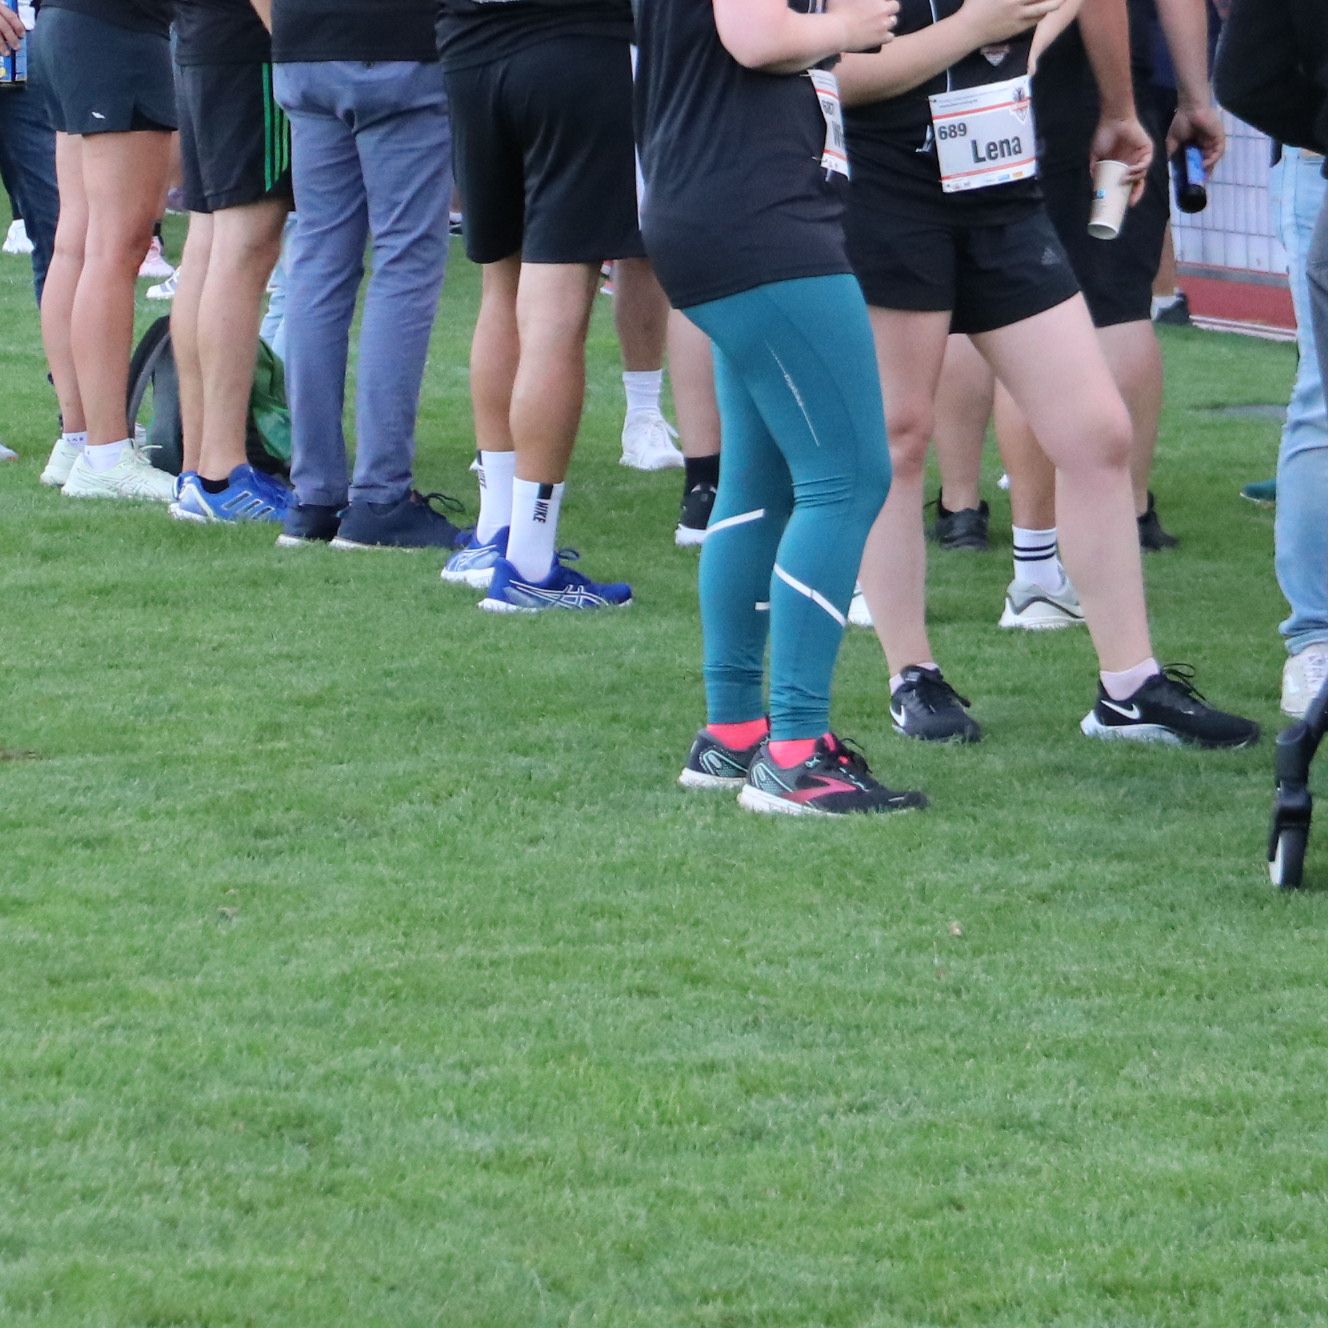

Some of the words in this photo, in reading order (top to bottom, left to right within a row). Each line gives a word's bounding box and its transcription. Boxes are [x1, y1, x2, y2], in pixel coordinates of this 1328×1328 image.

[938, 122, 967, 140] 689
[971, 136, 1022, 163] Lena
[533, 500, 549, 524] NIKE
